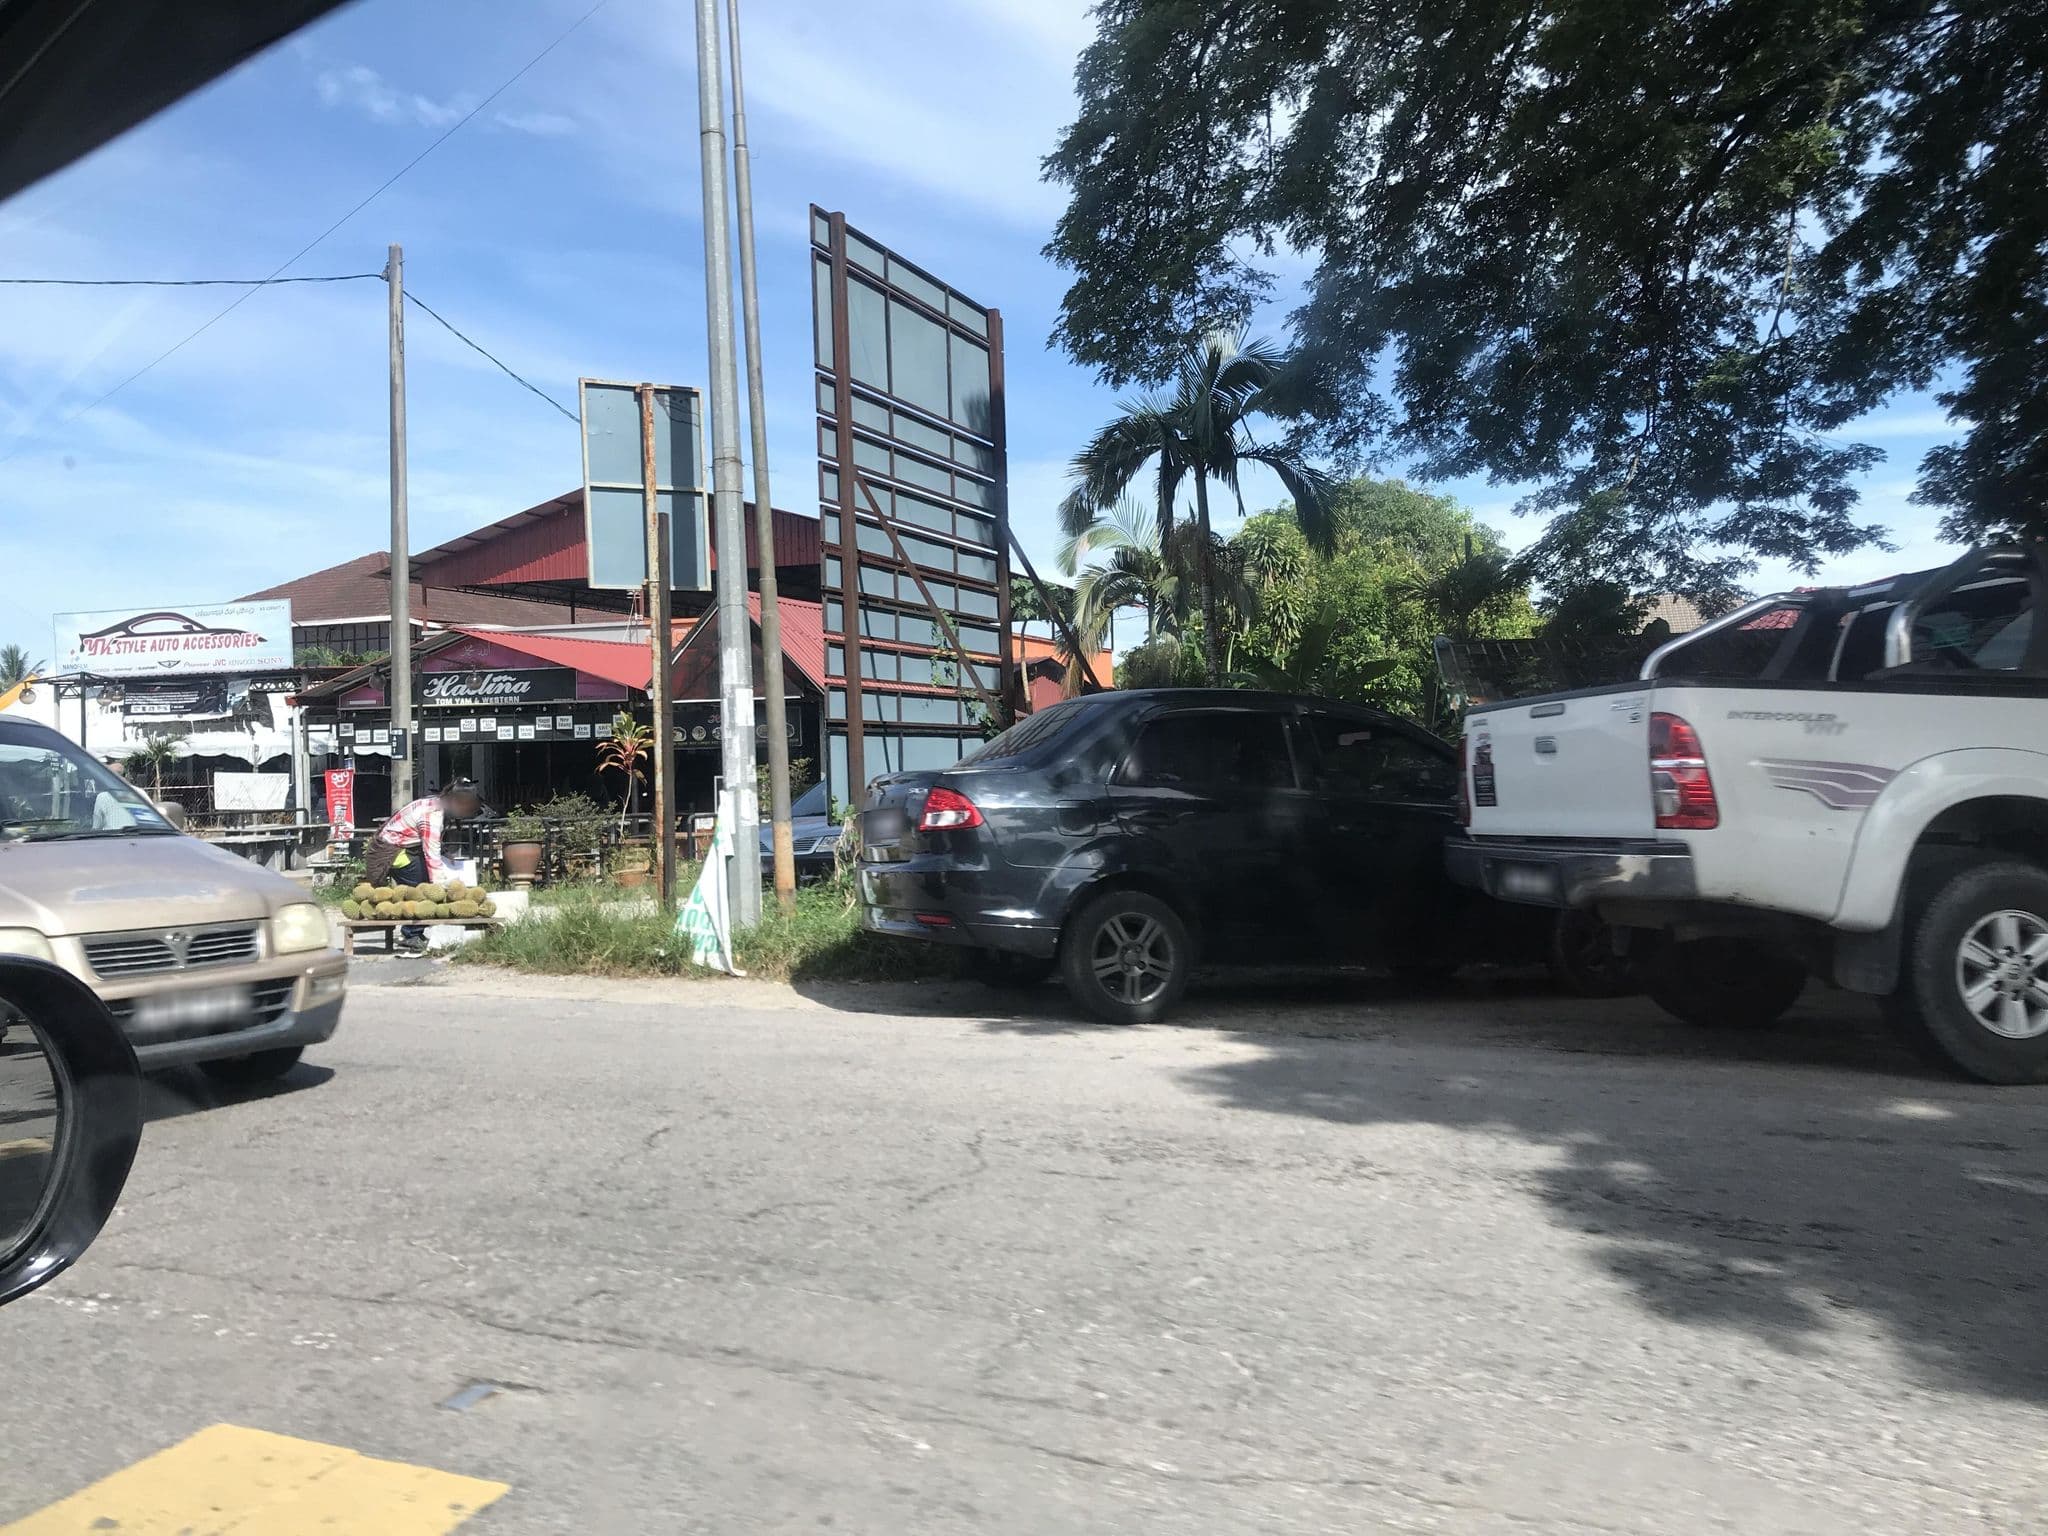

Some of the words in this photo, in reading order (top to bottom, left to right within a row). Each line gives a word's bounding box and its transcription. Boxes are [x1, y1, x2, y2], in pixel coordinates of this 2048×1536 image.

[116, 639, 147, 654] STYLE
[150, 637, 179, 652] AUTO
[183, 632, 258, 651] ACCESSORIES
[213, 659, 227, 667] JVC
[257, 656, 285, 666] SONY
[435, 697, 453, 705] TOM
[455, 697, 473, 705] YAM
[482, 696, 520, 704] WESTERN
[1727, 710, 1838, 722] INTERCOOLER
